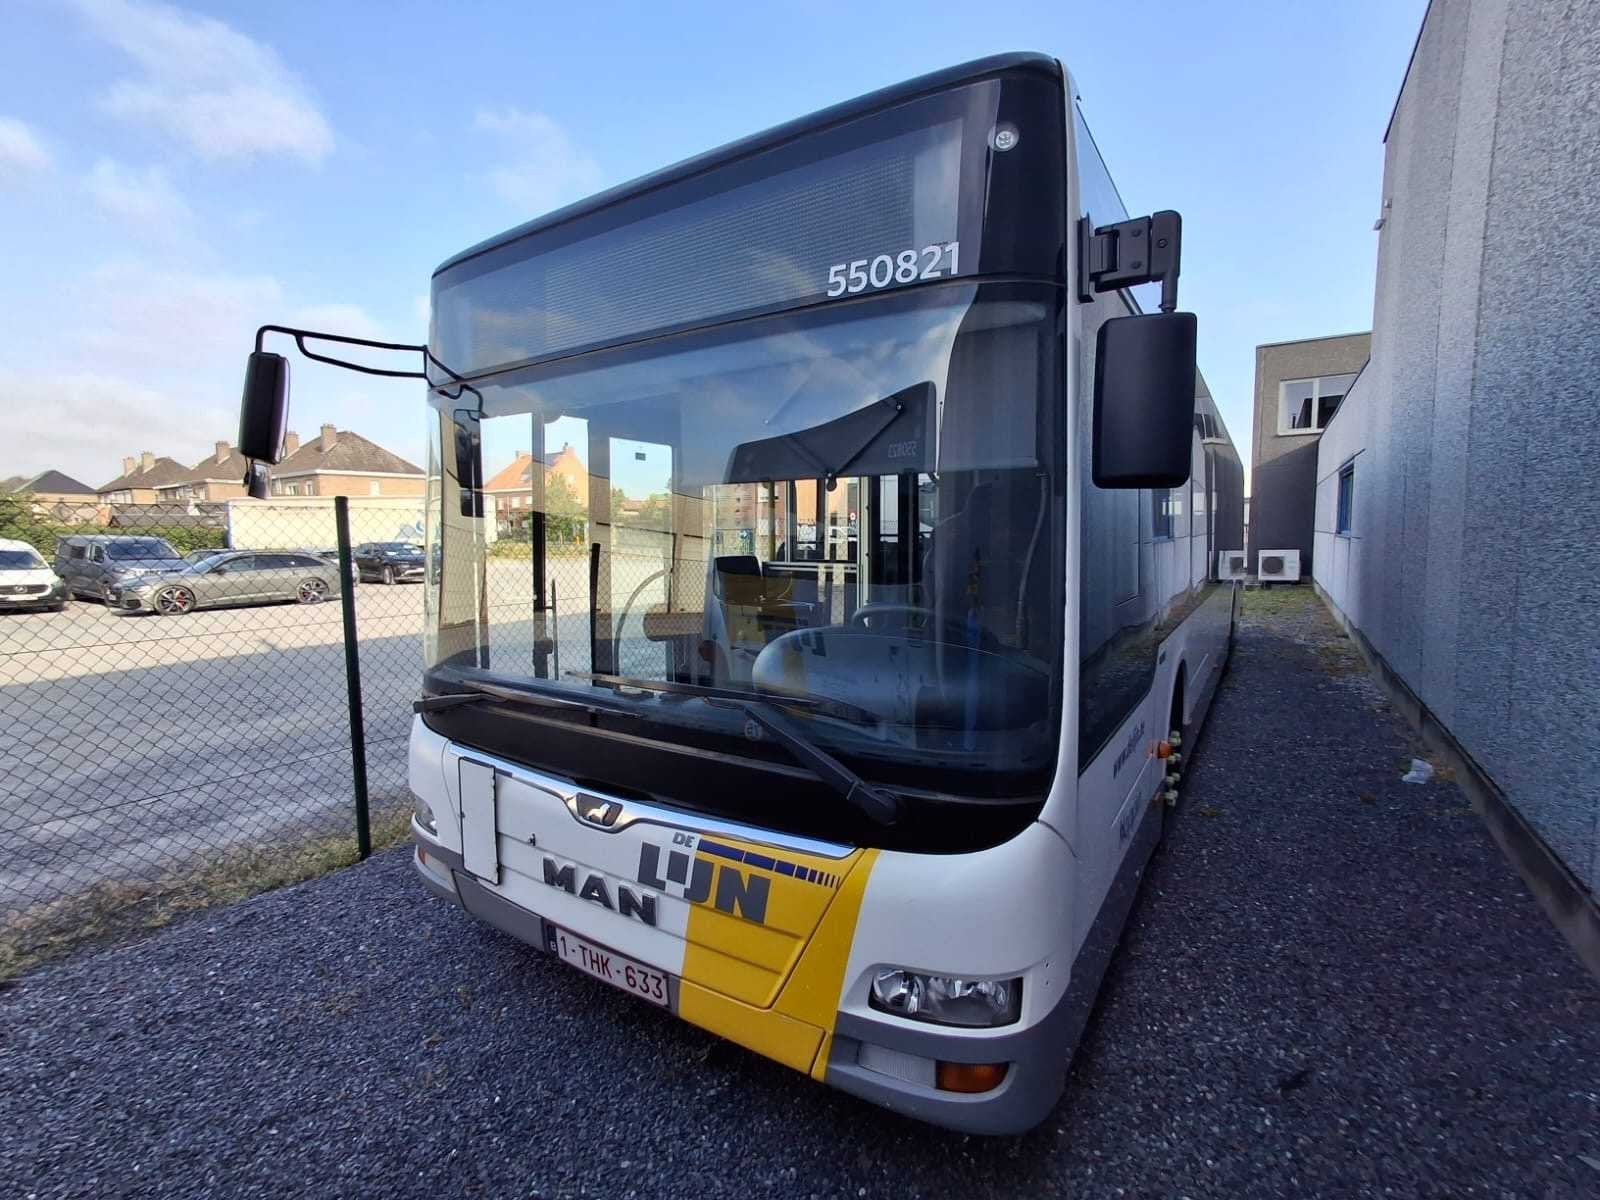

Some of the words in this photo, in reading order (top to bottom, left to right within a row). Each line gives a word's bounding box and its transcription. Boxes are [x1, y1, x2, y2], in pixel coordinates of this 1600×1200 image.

[827, 241, 960, 297] 550821
[672, 831, 695, 849] DE
[542, 854, 657, 927] MAN
[637, 841, 772, 924] LIJN
[560, 935, 664, 999] 1-THK-633
